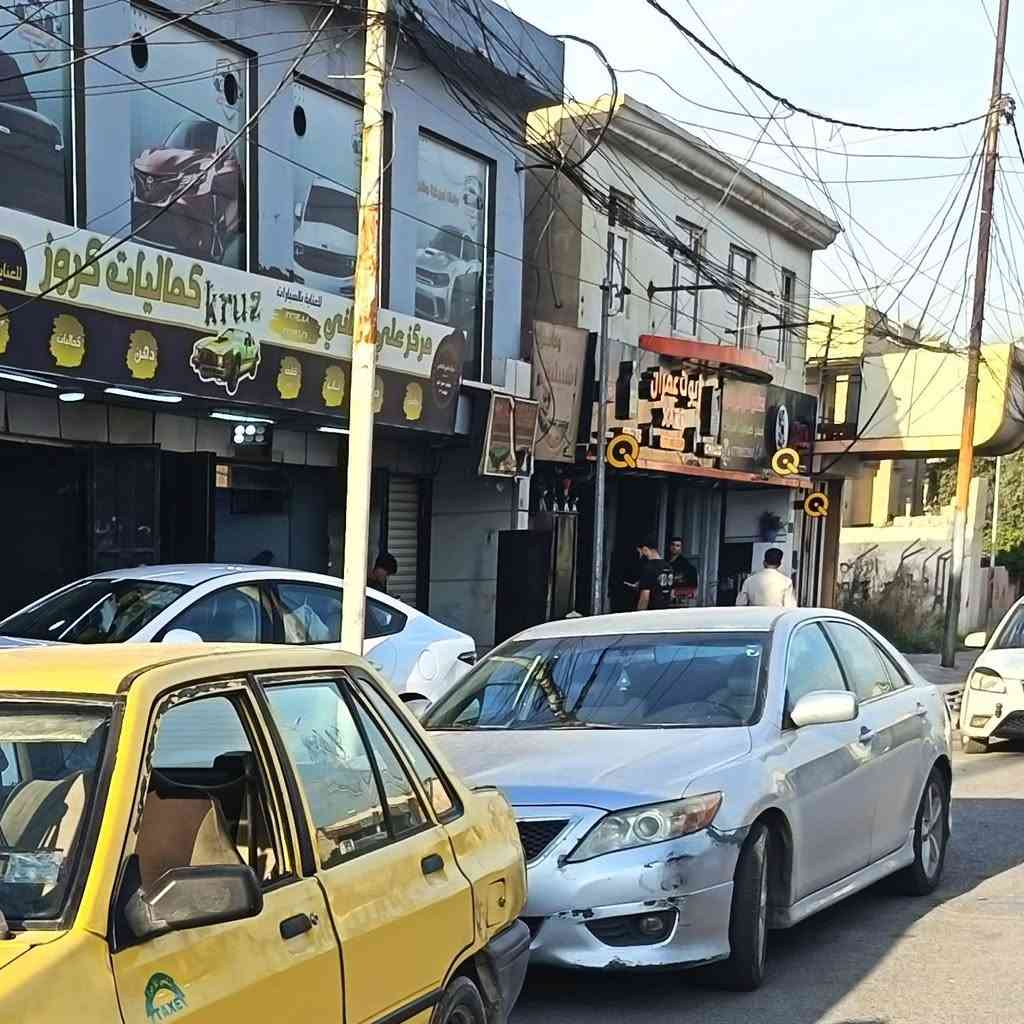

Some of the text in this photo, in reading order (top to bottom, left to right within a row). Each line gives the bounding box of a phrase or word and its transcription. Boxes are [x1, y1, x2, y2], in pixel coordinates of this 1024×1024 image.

[38, 231, 204, 316] كماليات كروز
[205, 280, 262, 327] kruz
[403, 323, 433, 362] مركز
